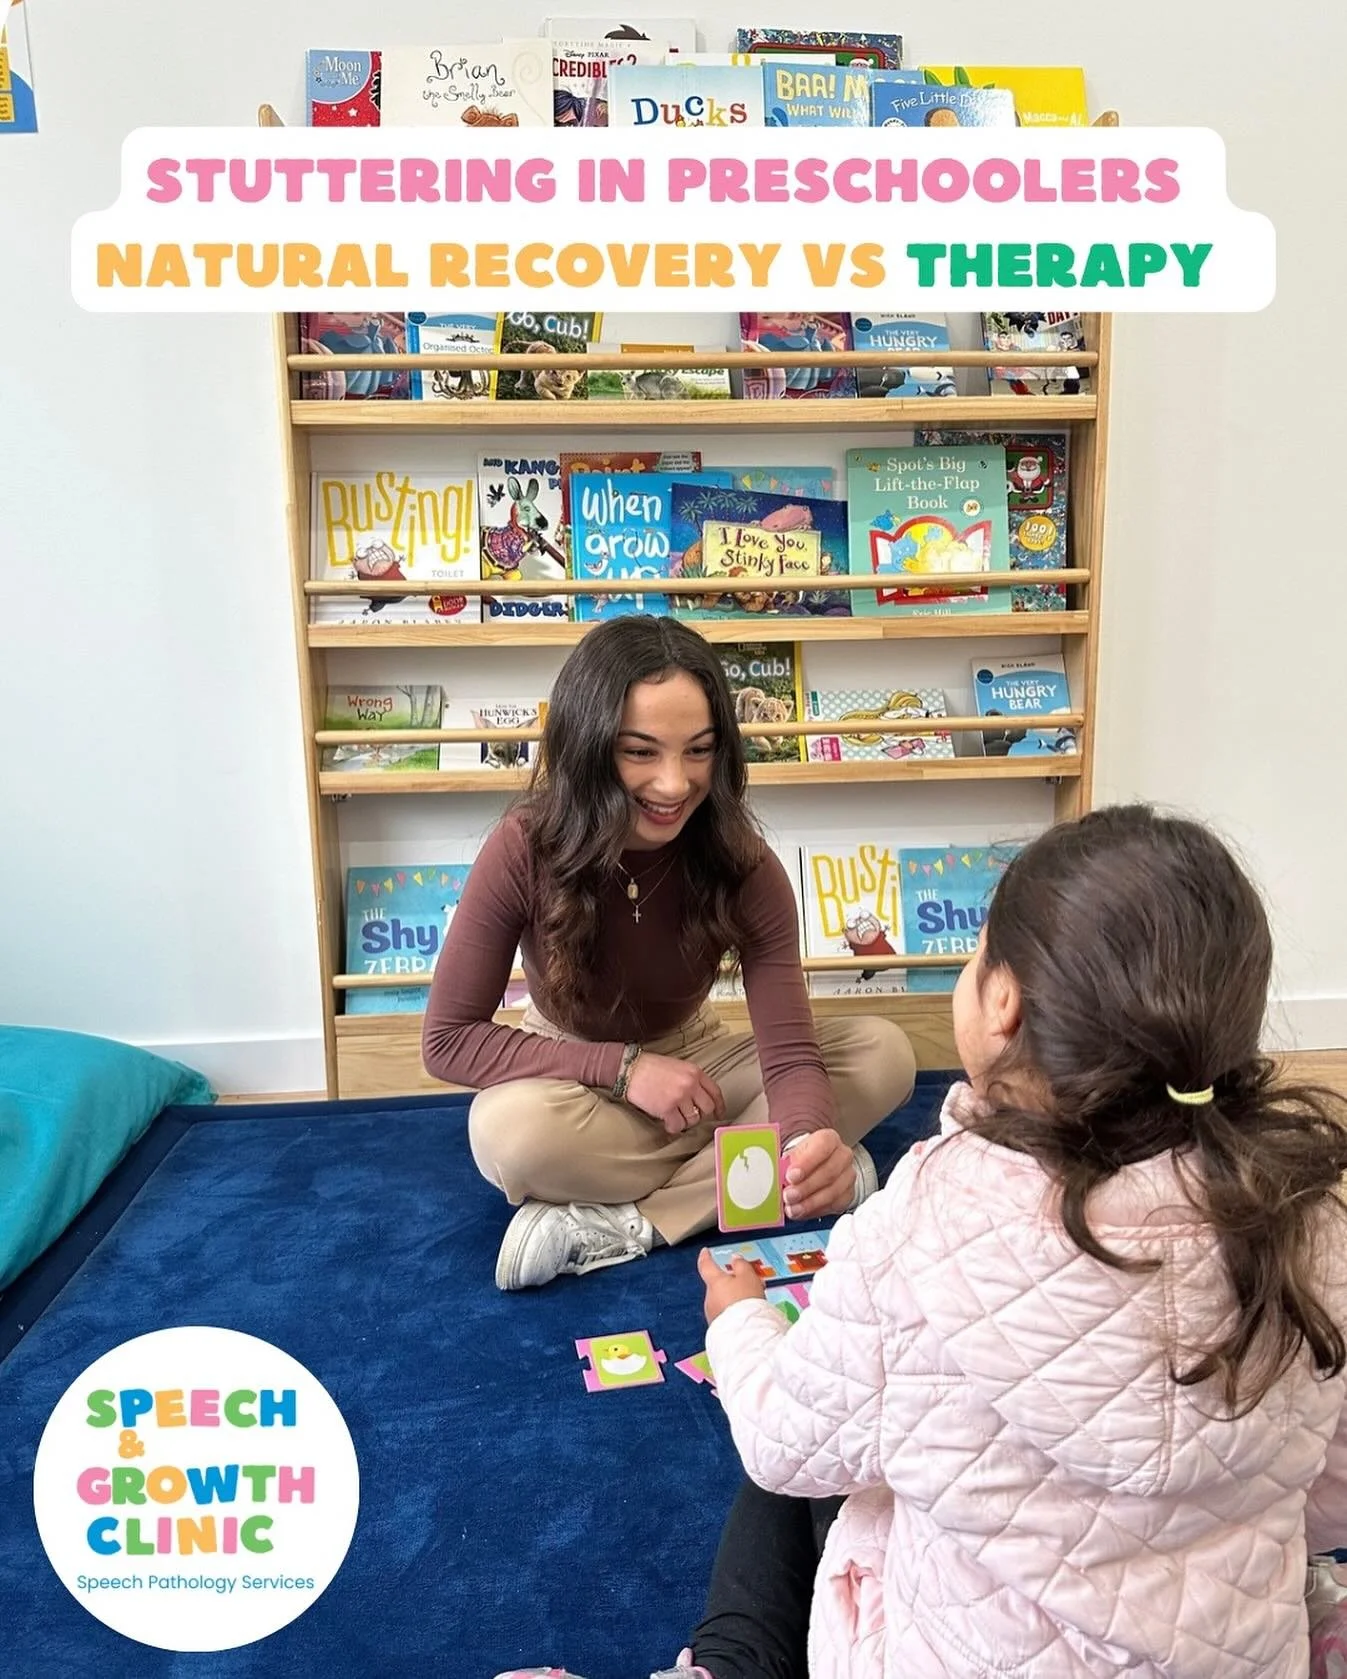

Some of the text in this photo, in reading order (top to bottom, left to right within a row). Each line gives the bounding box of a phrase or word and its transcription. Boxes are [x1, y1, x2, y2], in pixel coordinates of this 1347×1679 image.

[325, 56, 361, 72] Moon
[426, 50, 506, 86] Brian
[553, 56, 624, 78] CREDIBL
[341, 71, 360, 85] Me
[776, 69, 836, 101] BAA!
[443, 82, 486, 104] Smelly
[630, 95, 748, 126] Ducks
[787, 103, 824, 116] WHAT
[891, 97, 918, 113] Five
[919, 91, 956, 106] Little
[544, 315, 588, 340] Cub!
[423, 342, 467, 351] Organised
[870, 334, 938, 348] HUNGRY
[505, 458, 560, 475] KANG
[887, 456, 966, 474] Spot's Big
[874, 476, 980, 492] Lift-the-Flap
[582, 478, 662, 527] When
[907, 495, 948, 509] Book
[322, 471, 474, 568] Busting!
[735, 528, 769, 550] Love
[720, 549, 810, 577] Stinky Face
[431, 569, 464, 578] TOILET
[749, 657, 791, 677] Cub!
[991, 684, 1057, 699] HUNGRY
[347, 695, 393, 712] Wrong
[1008, 698, 1042, 710] BEAR
[357, 708, 386, 722] Way
[812, 844, 902, 937] Busti
[916, 889, 938, 901] THE
[362, 907, 386, 921] THE
[916, 899, 988, 935] Shy
[361, 917, 439, 956] Shy
[833, 986, 883, 996] AARON
